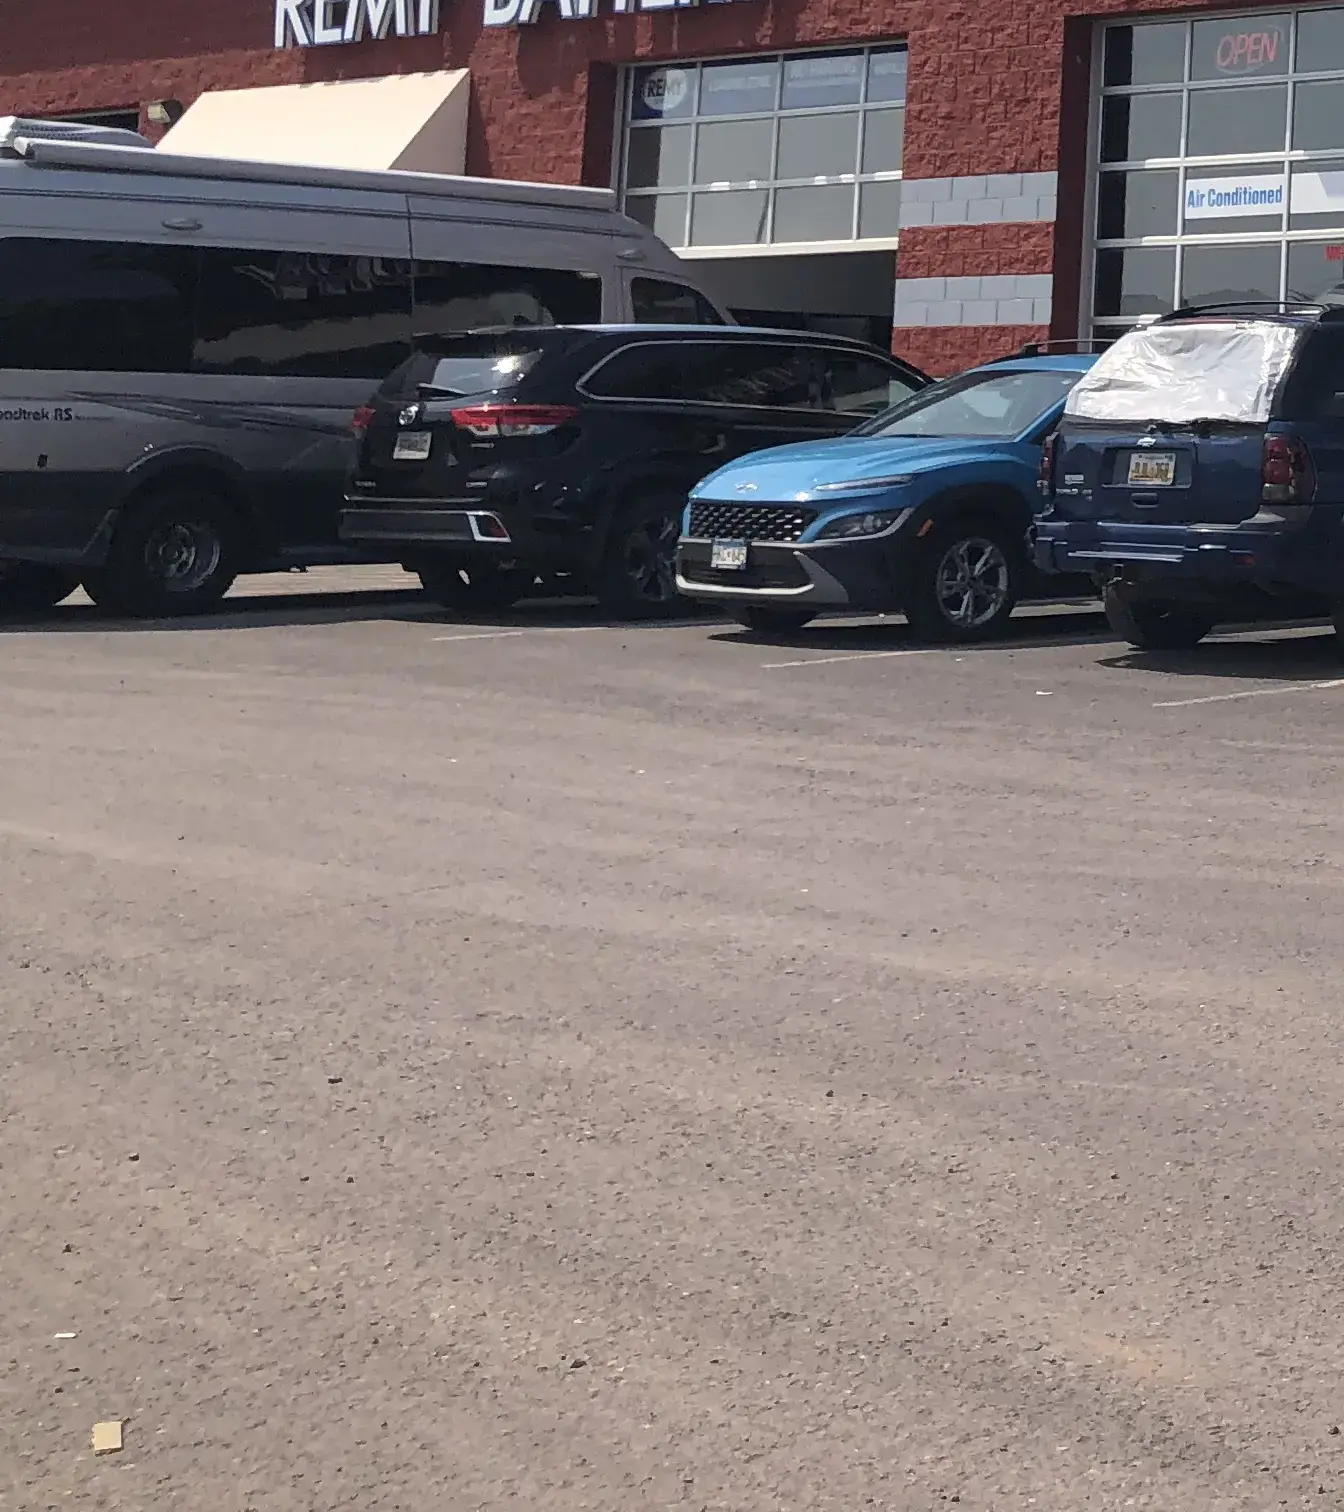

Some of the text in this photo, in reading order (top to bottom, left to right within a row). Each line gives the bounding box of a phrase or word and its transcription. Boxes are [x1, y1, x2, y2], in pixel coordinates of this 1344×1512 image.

[1216, 32, 1279, 67] OPEN
[1187, 185, 1283, 208] Air Conditioned
[54, 407, 73, 421] RS
